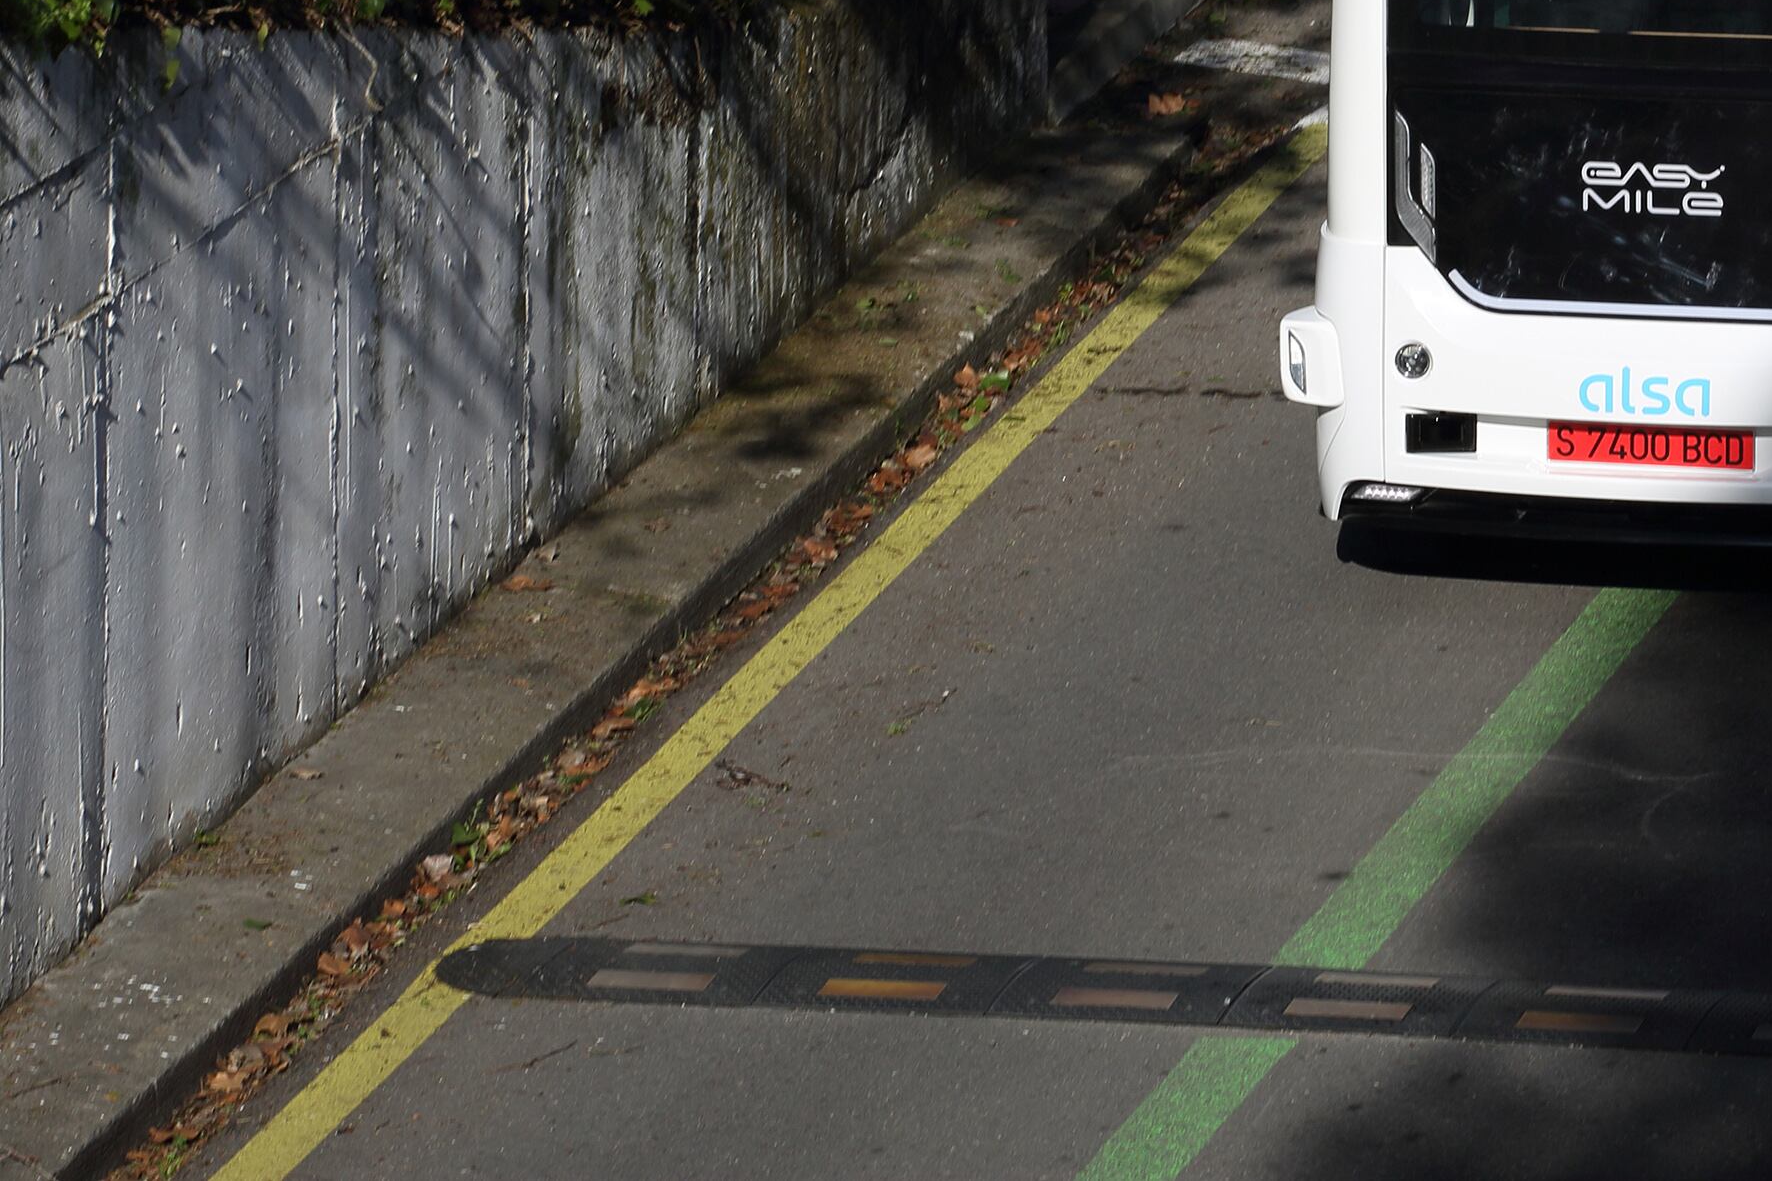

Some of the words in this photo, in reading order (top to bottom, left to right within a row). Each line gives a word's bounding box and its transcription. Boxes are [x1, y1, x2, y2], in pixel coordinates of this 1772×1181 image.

[1579, 366, 1711, 417] alsa
[1556, 426, 1575, 456] S
[1587, 427, 1670, 461] 7400
[1682, 432, 1744, 466] BCD
